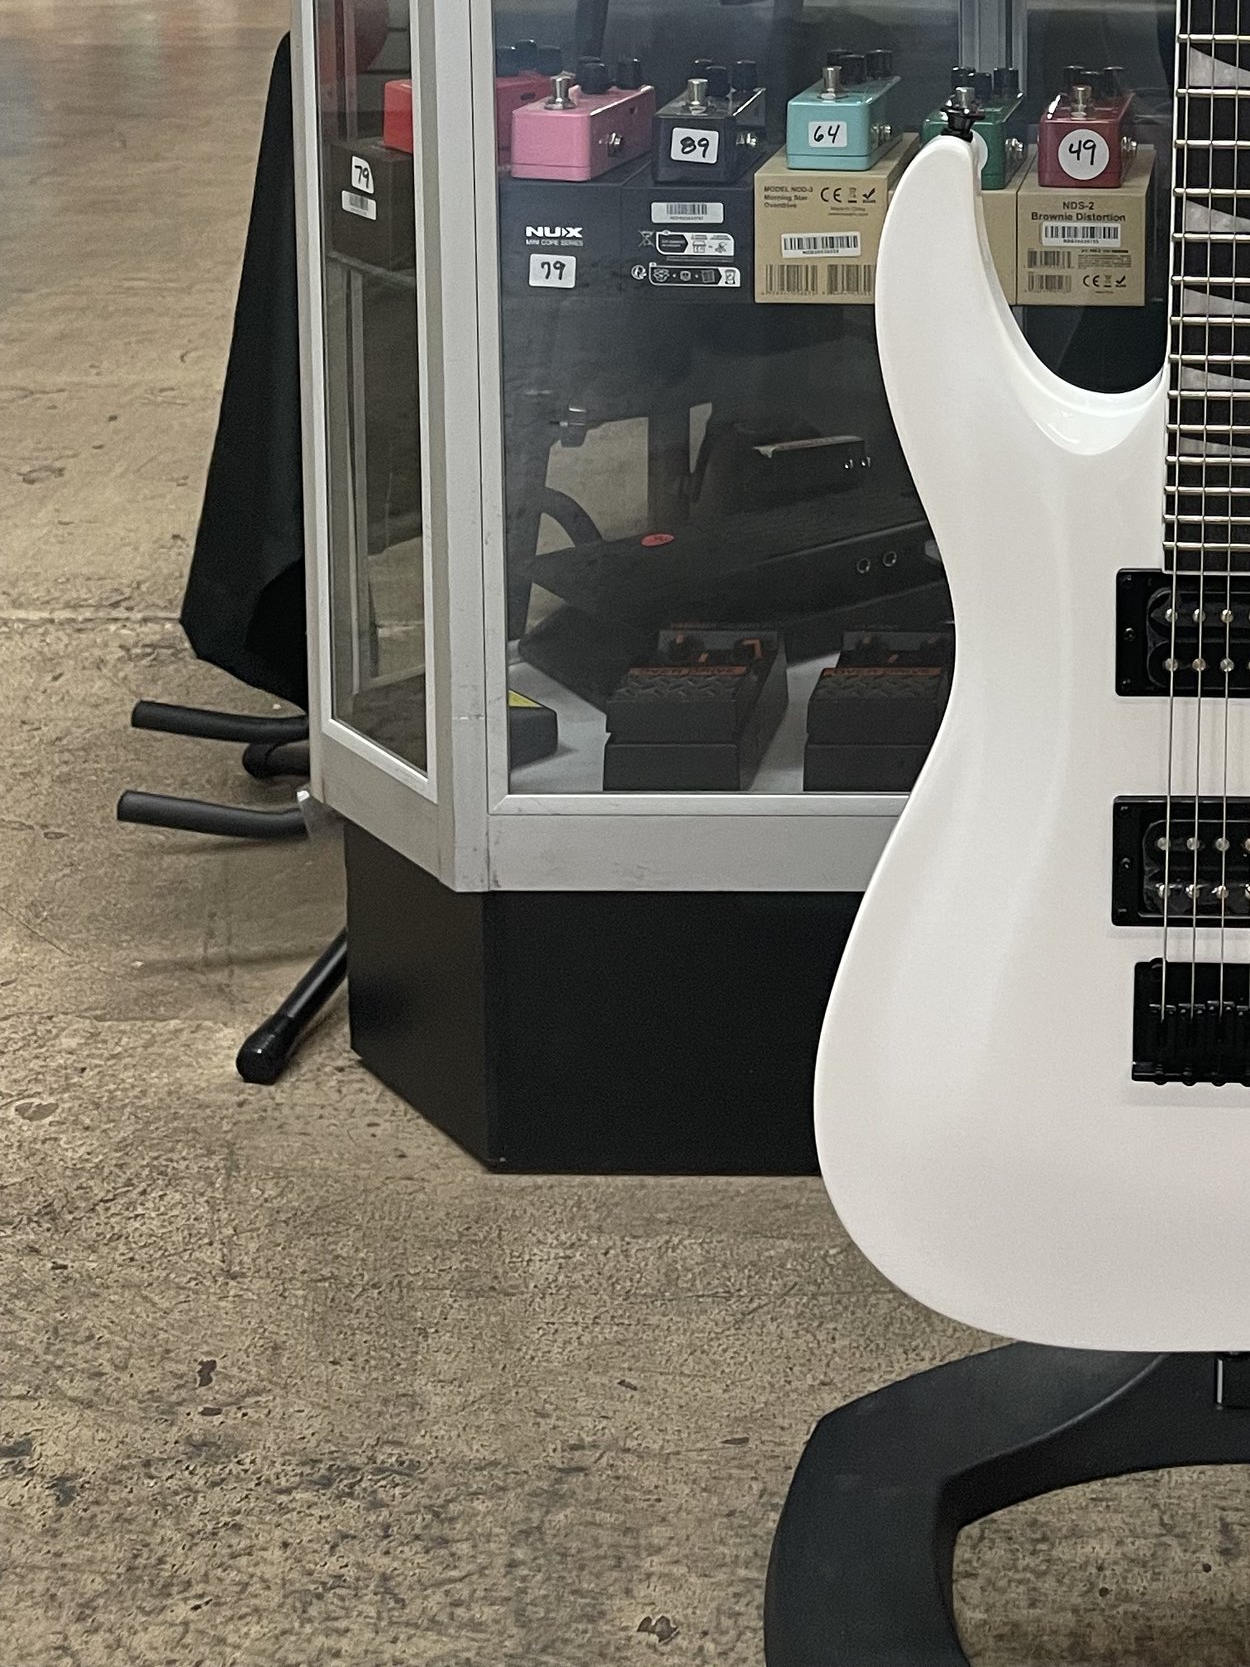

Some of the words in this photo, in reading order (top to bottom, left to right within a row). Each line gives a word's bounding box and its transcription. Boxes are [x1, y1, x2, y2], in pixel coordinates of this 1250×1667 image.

[813, 124, 841, 144] 64
[680, 136, 709, 158] 89
[1069, 139, 1097, 166] 49
[354, 165, 370, 189] 79
[1062, 201, 1095, 211] NDS-2
[1031, 214, 1074, 222] Brownie
[1076, 213, 1126, 222] Distortion
[525, 226, 583, 238] NUX
[540, 260, 566, 281] 79
